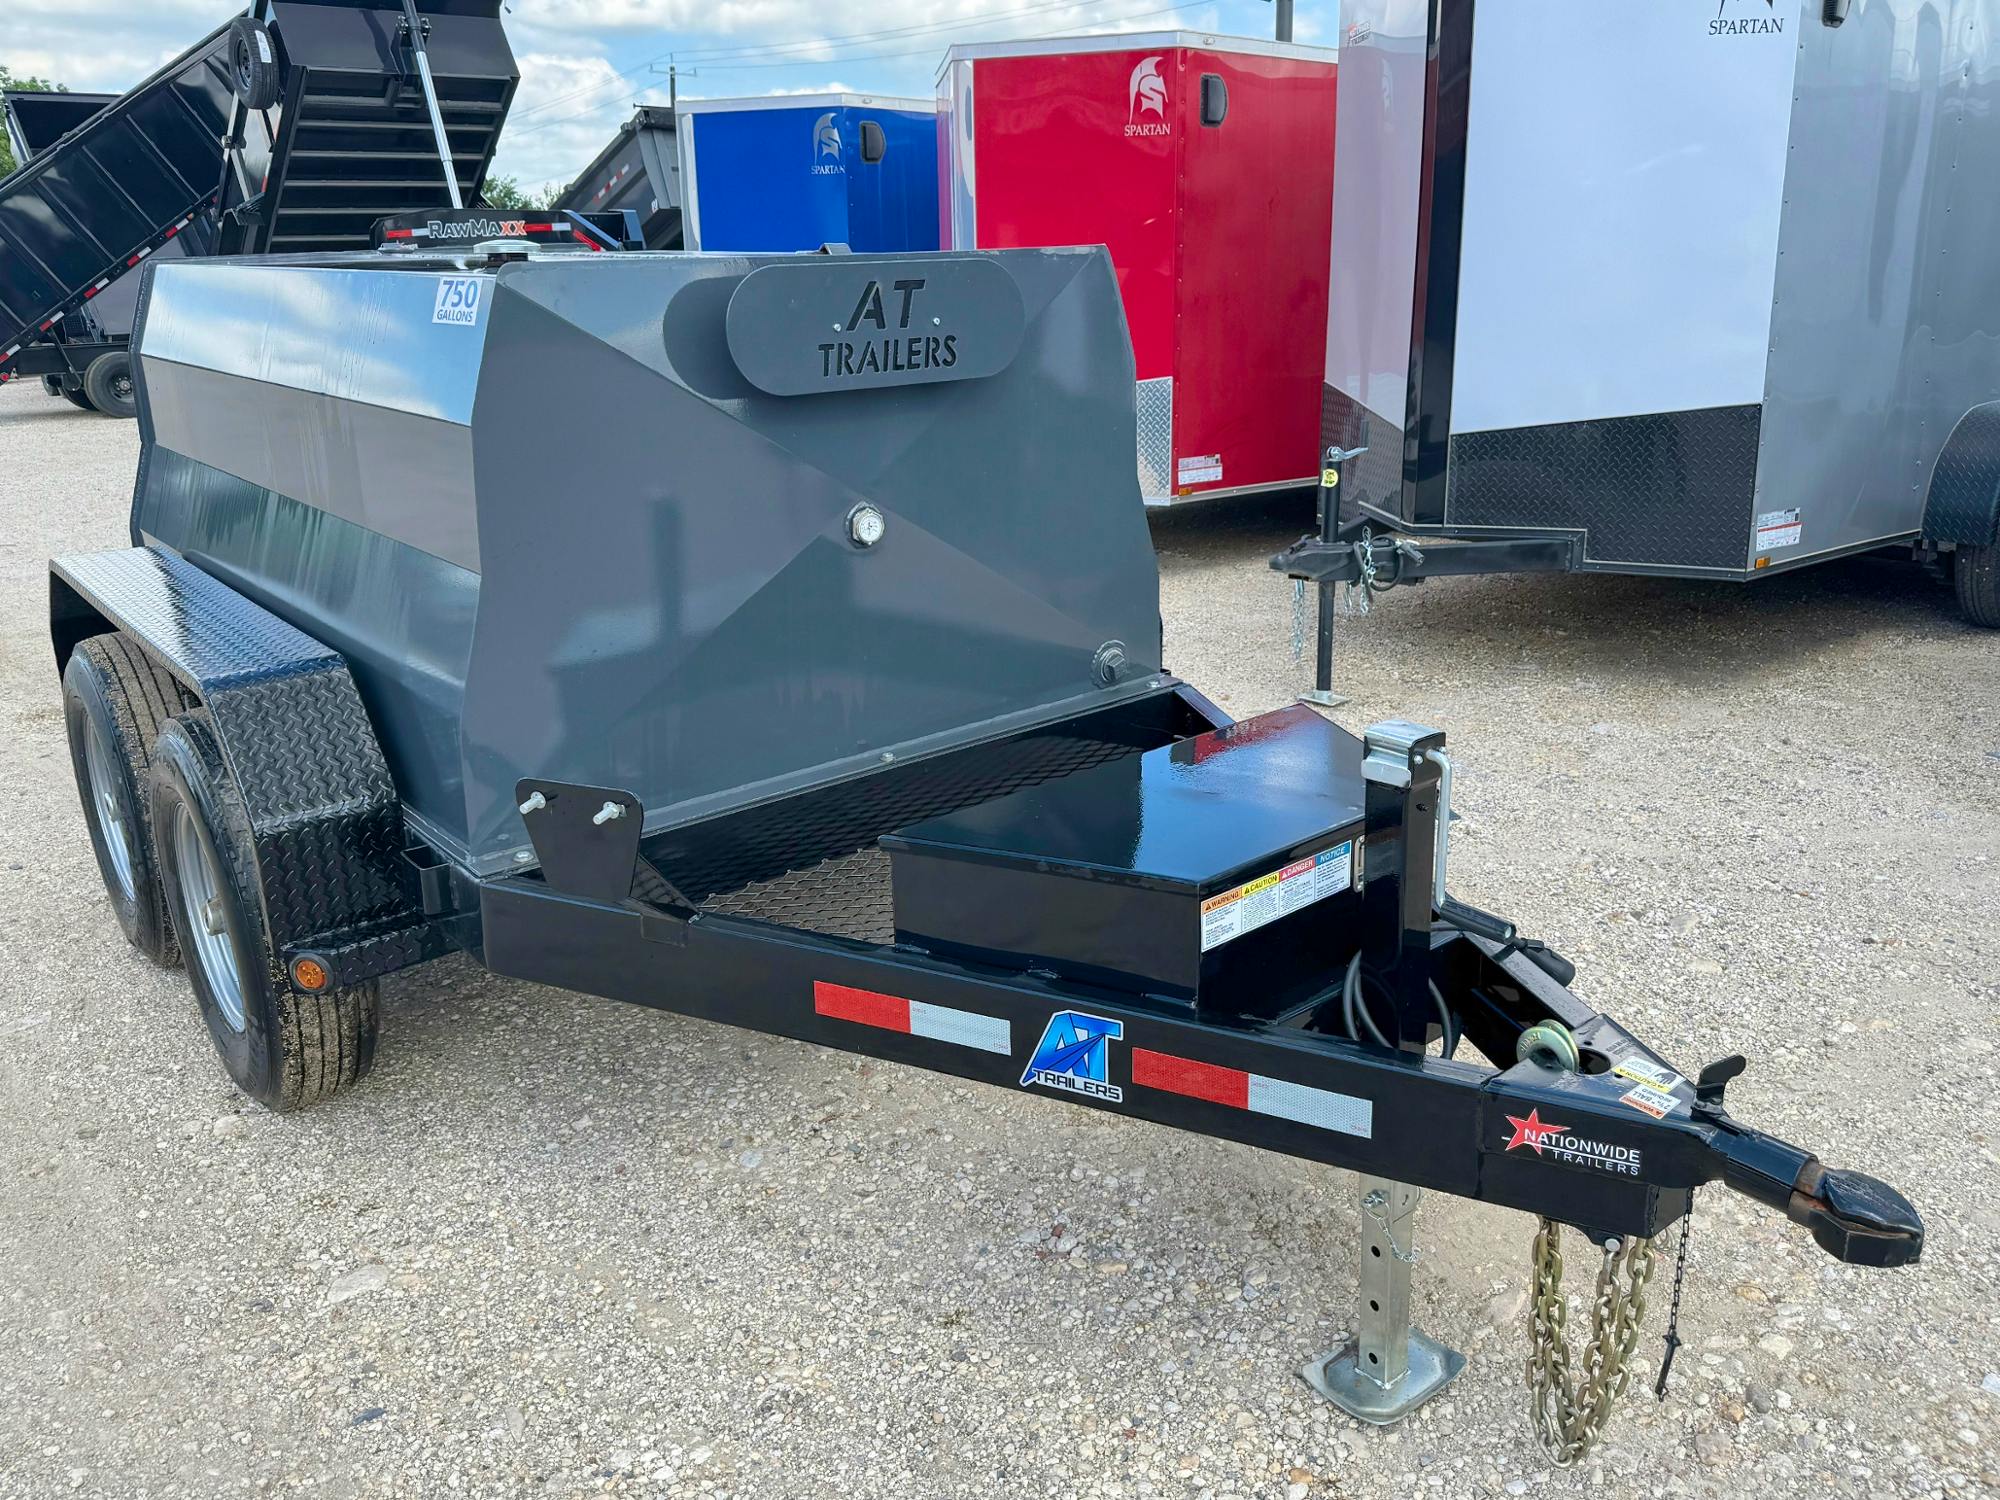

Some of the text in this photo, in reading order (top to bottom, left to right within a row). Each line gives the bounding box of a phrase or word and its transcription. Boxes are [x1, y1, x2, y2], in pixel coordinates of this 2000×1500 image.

[1708, 17, 1785, 36] SPARTAN
[1124, 123, 1171, 137] SPARTAN
[811, 164, 846, 175] SPARTAN
[441, 280, 478, 308] 750
[846, 279, 926, 331] AT
[436, 309, 474, 323] GALLONS
[817, 334, 958, 378] TRAILERS
[1320, 846, 1346, 864] NOTICE
[1287, 859, 1314, 875] DANGER
[1250, 874, 1278, 892] CAUTION
[1211, 891, 1239, 908] WARNING
[1021, 1011, 1121, 1085] AT
[1033, 1069, 1121, 1100] TRAILERS
[1524, 1128, 1641, 1163] NATIONWIDE
[1553, 1149, 1639, 1176] TRAILERS
